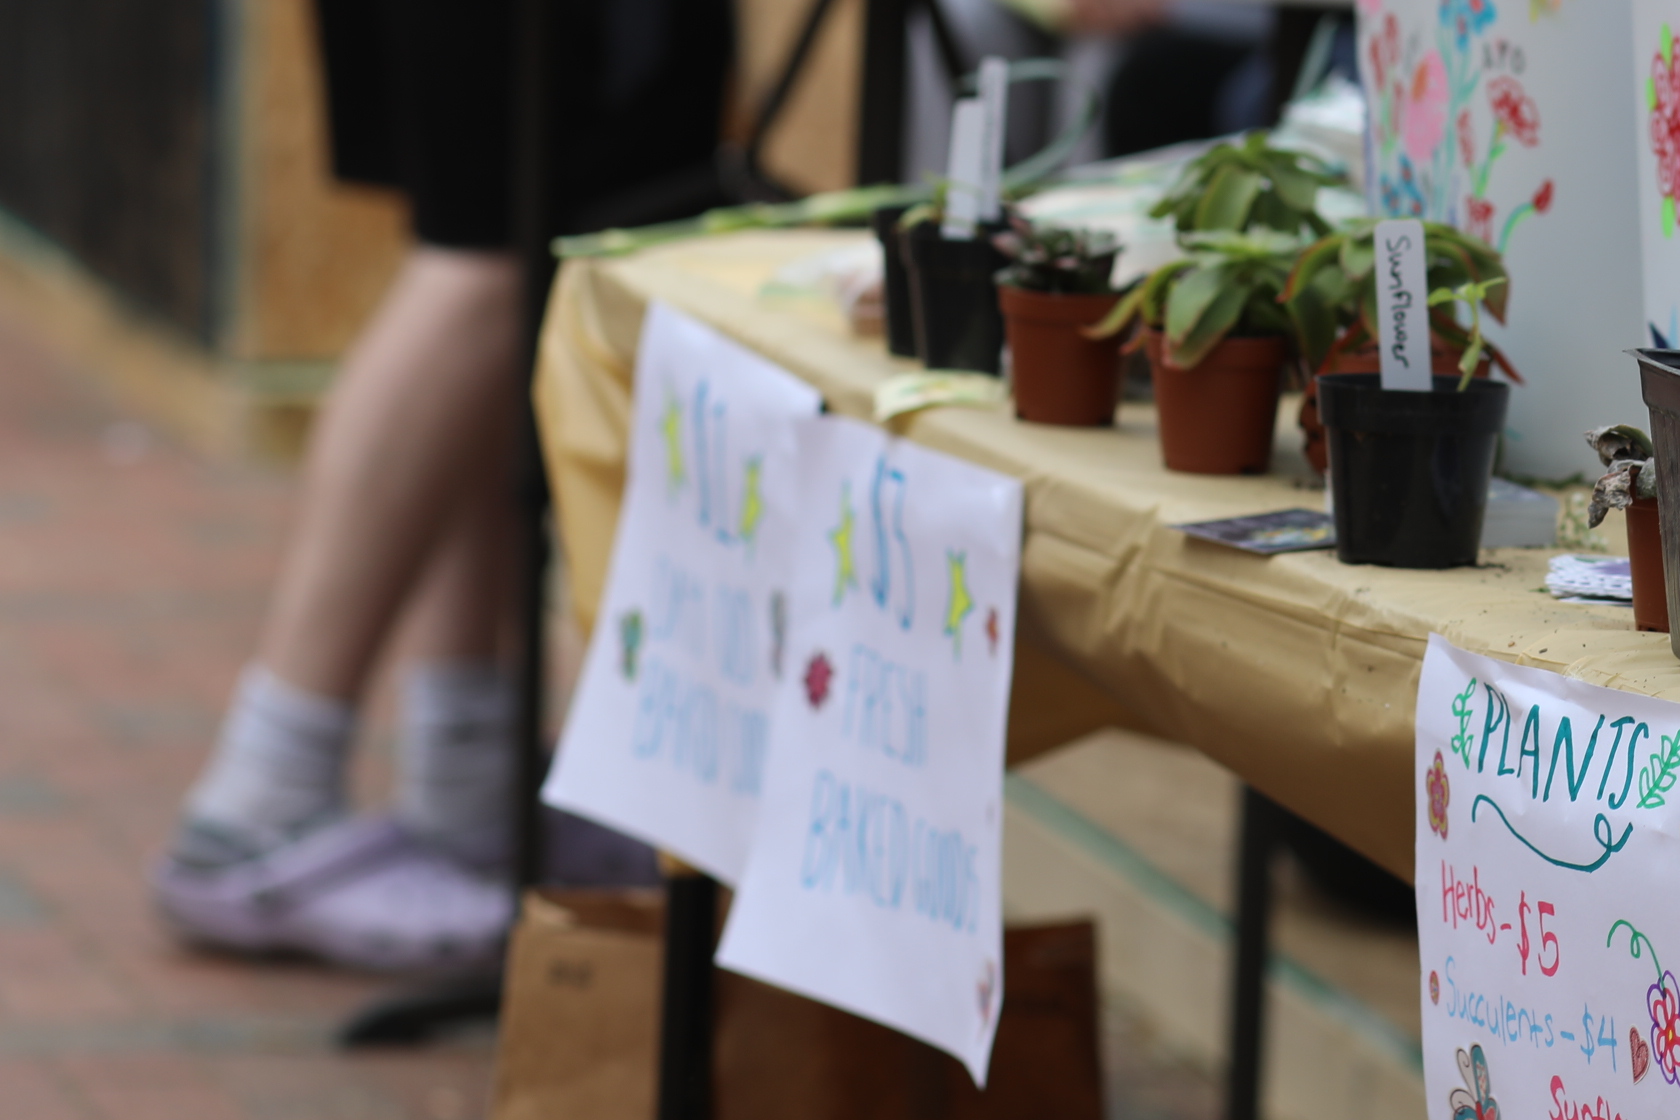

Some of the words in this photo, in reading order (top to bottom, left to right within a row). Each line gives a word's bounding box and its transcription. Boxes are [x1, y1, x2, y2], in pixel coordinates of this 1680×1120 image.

[1386, 235, 1413, 369] Sunflower
[1477, 682, 1650, 809] PLANTS
[800, 768, 909, 910] BAKED
